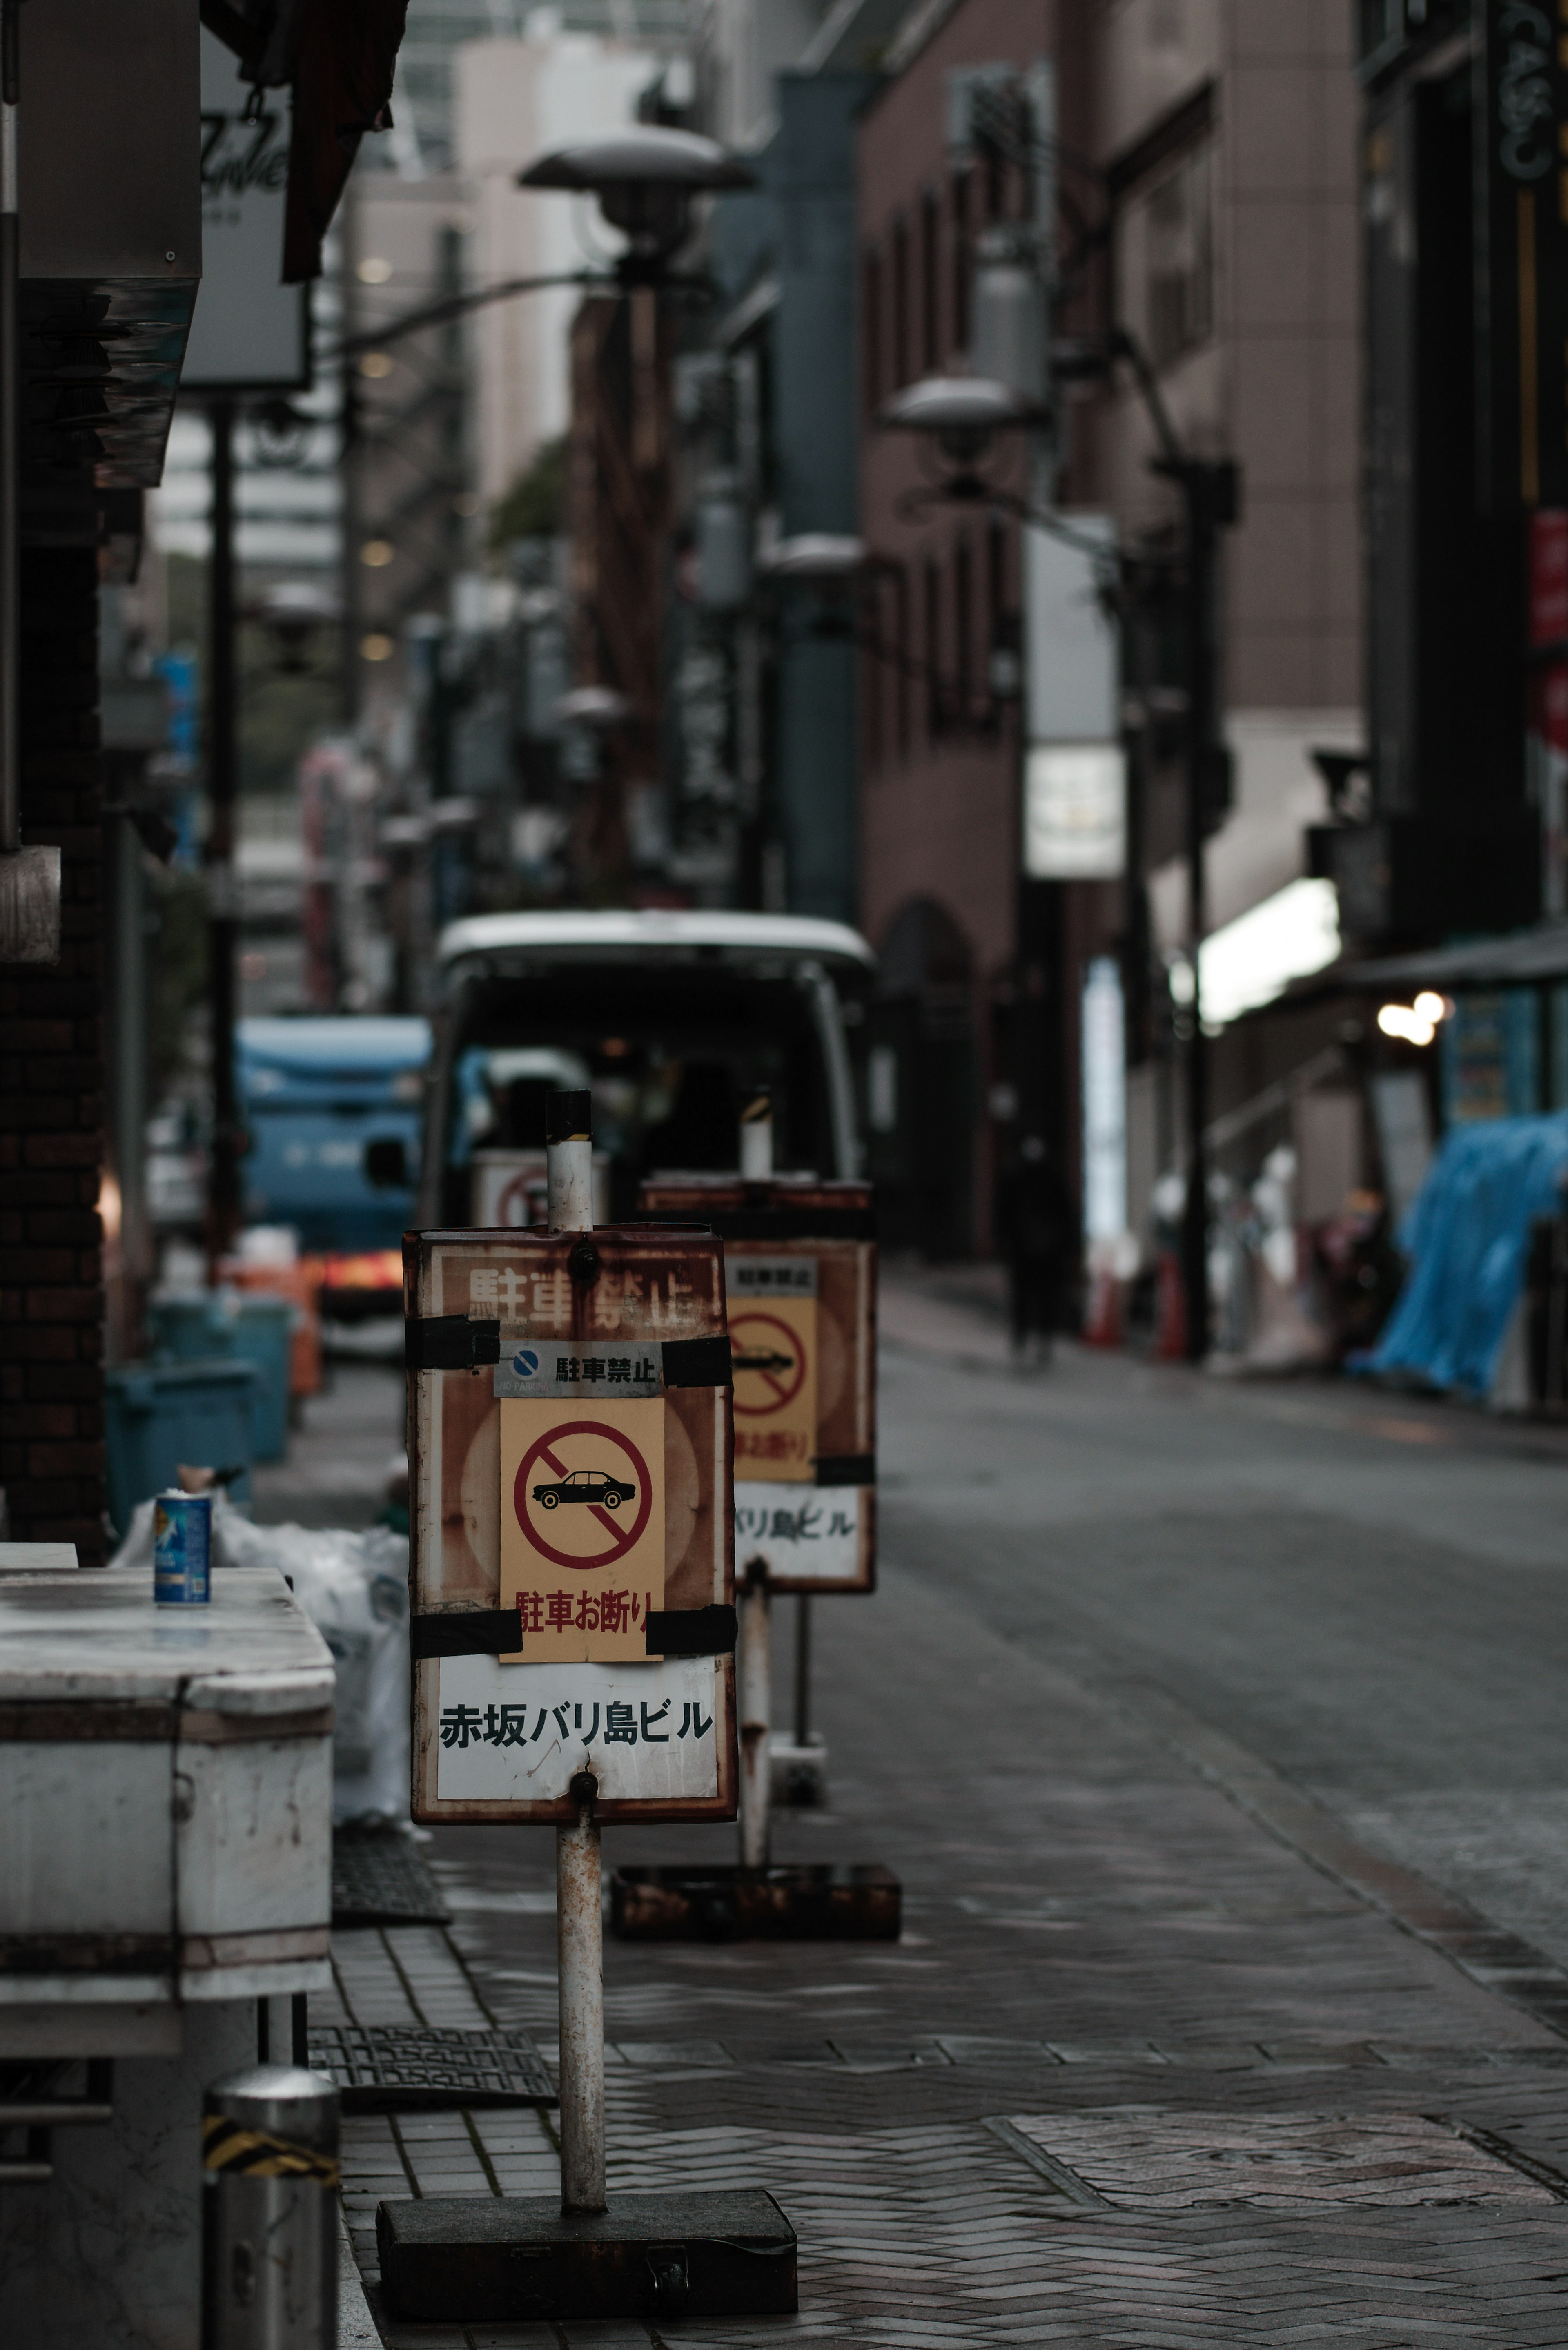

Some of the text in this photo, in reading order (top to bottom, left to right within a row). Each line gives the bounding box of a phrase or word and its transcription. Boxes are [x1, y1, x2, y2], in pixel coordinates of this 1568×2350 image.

[1498, 0, 1554, 181] CASSO
[469, 1267, 697, 1329] 駐車禁止
[499, 1382, 549, 1391] NO PARKING
[556, 1358, 656, 1383] 駐車禁止
[516, 1590, 651, 1633] 駐車お断り
[440, 1698, 713, 1748] 赤坂バリ島ビル
